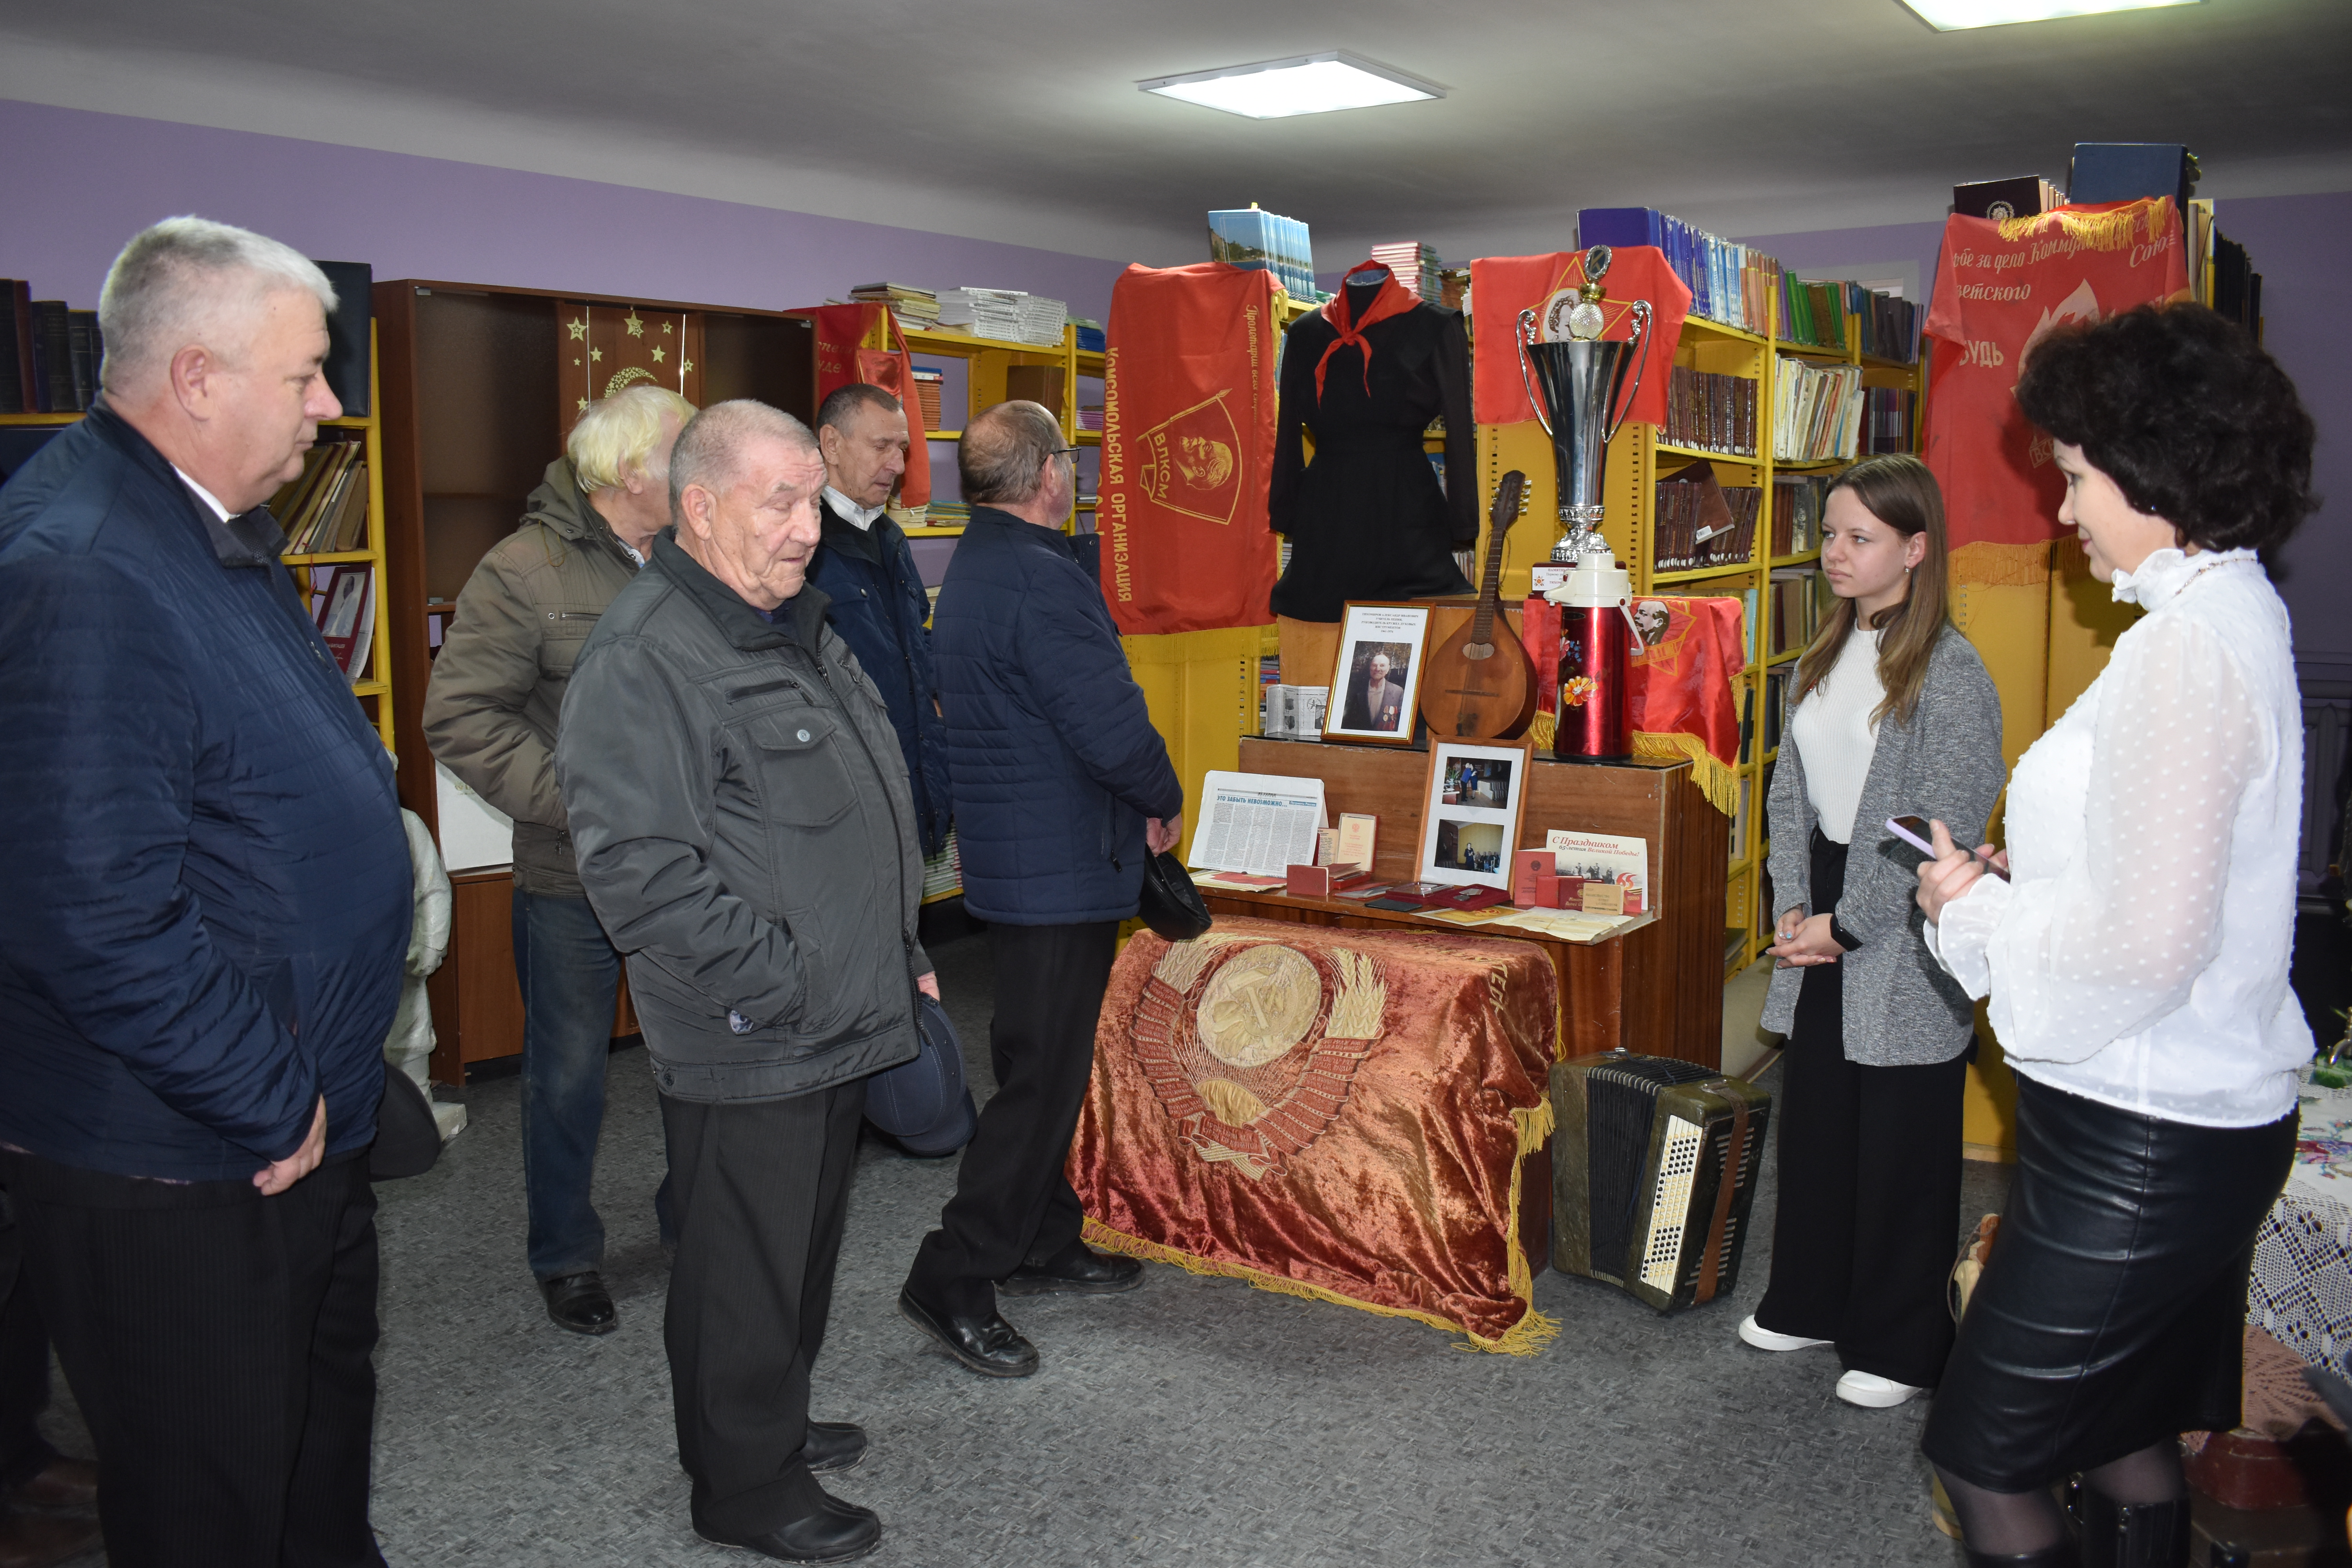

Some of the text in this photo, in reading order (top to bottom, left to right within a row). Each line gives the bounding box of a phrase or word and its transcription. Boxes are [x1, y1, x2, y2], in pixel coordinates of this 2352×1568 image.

[1976, 254, 1991, 268] за
[1994, 252, 2025, 274] дело
[1243, 304, 1260, 367] Пролетарии
[1154, 432, 1171, 499] ВЛКСМ
[1111, 493, 1132, 602] ОРГАНИЗАЦИЯ
[1247, 798, 1287, 807] НЕВОЗМОЖНО...
[1560, 837, 1619, 849] Праздником
